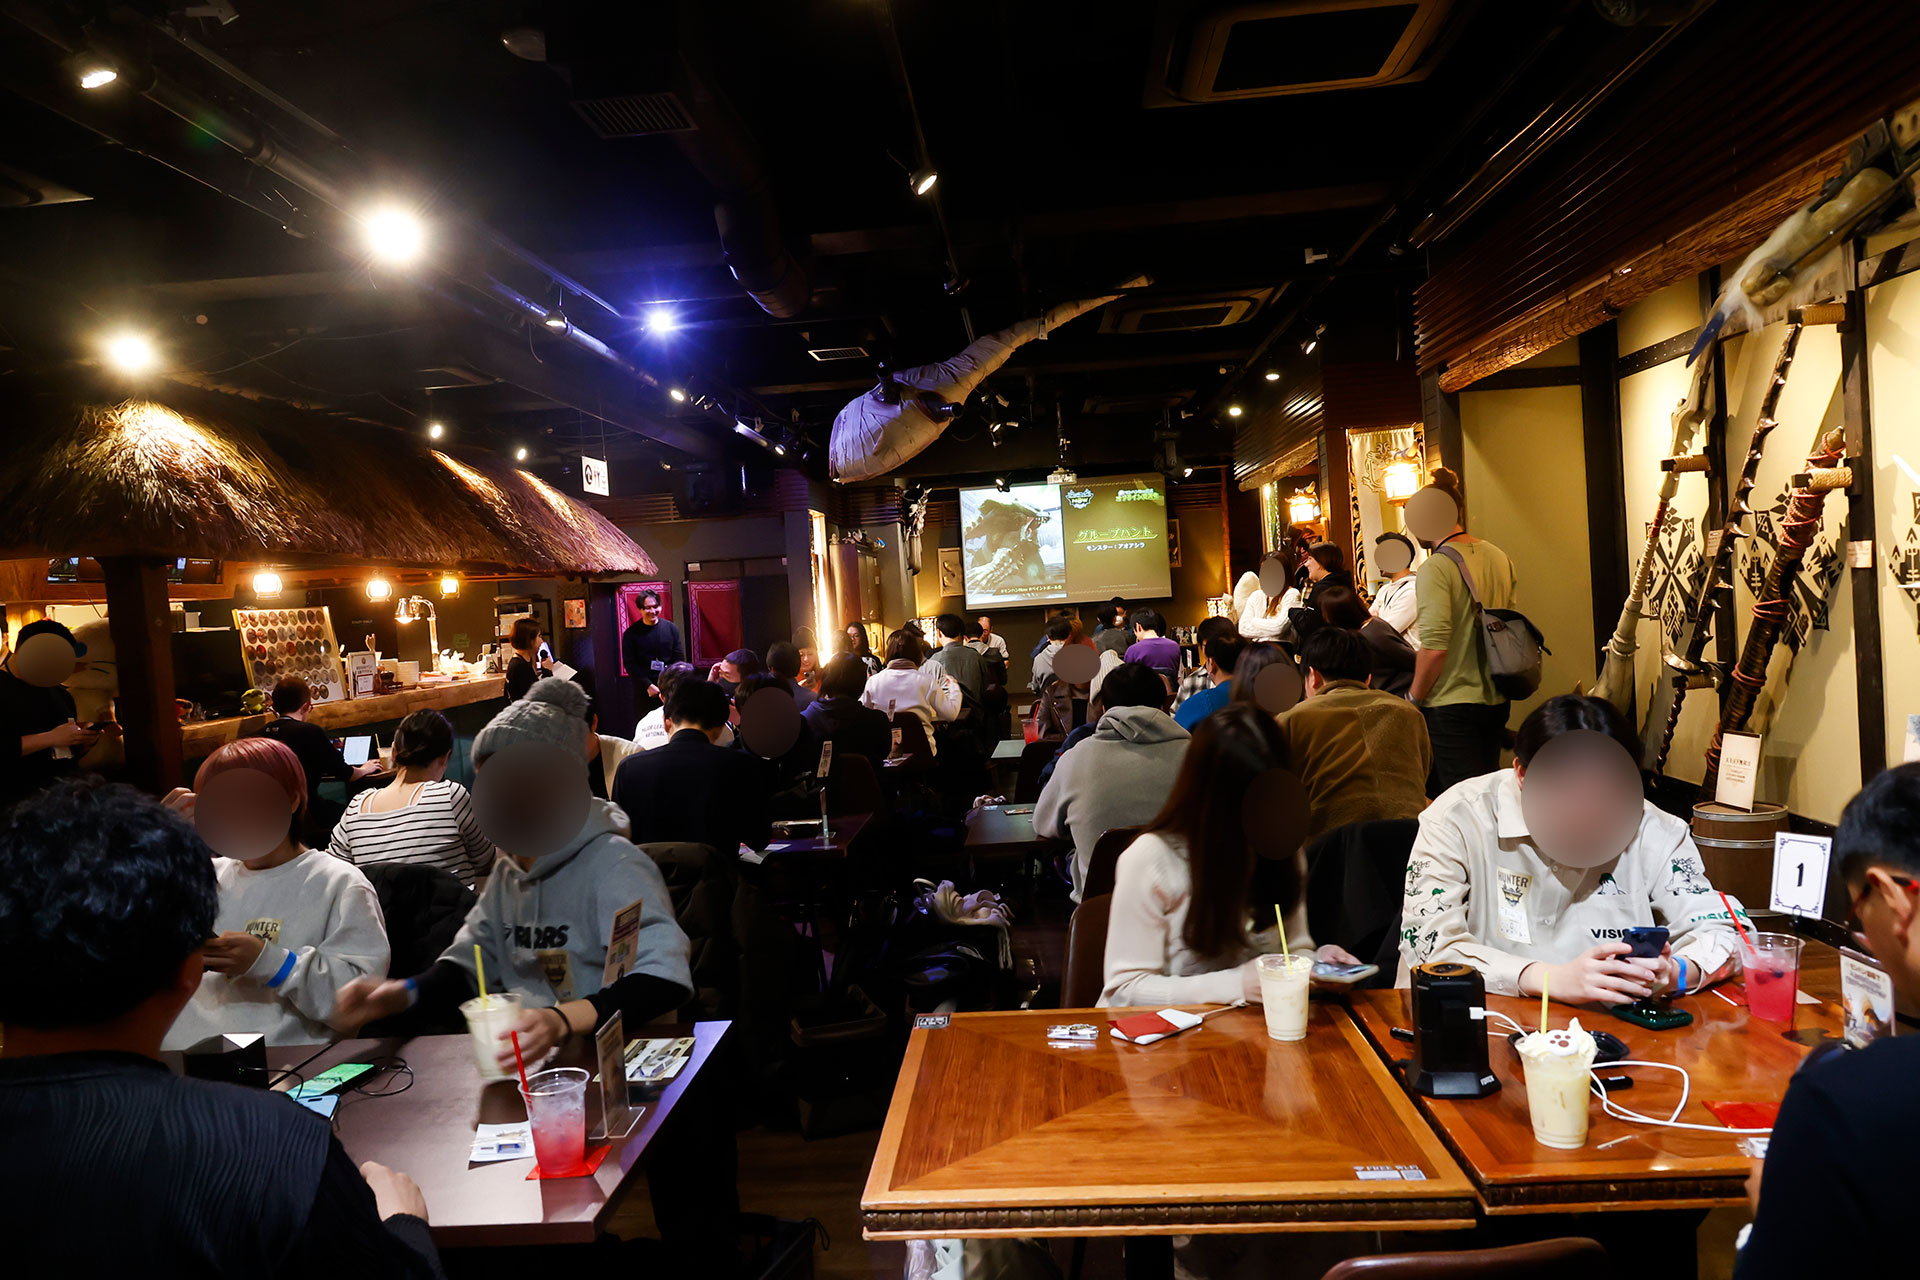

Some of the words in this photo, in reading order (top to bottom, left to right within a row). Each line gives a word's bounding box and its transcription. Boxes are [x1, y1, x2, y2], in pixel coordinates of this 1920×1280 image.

[1079, 527, 1151, 540] グループハント
[1796, 862, 1804, 887] 1
